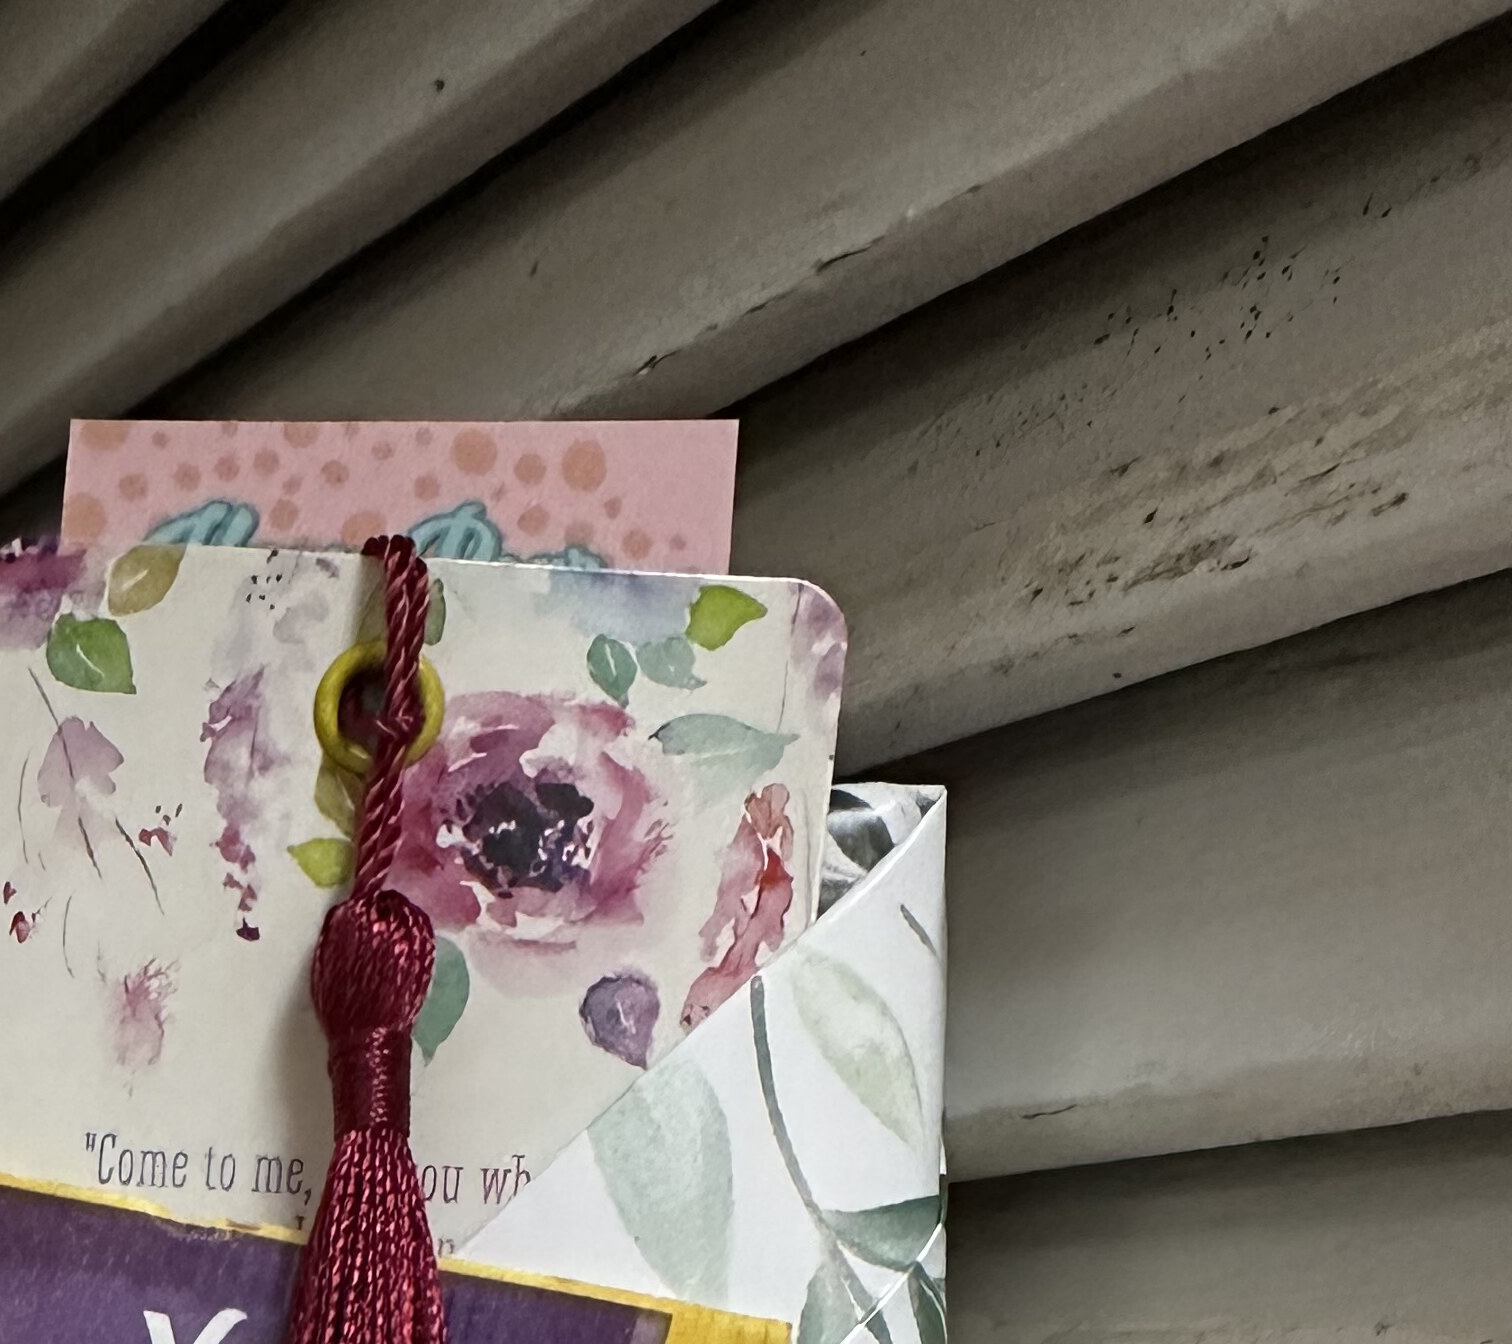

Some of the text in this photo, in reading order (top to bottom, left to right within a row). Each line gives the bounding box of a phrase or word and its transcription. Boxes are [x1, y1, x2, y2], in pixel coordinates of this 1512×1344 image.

[85, 1132, 532, 1207] "Come to me, ou wh
